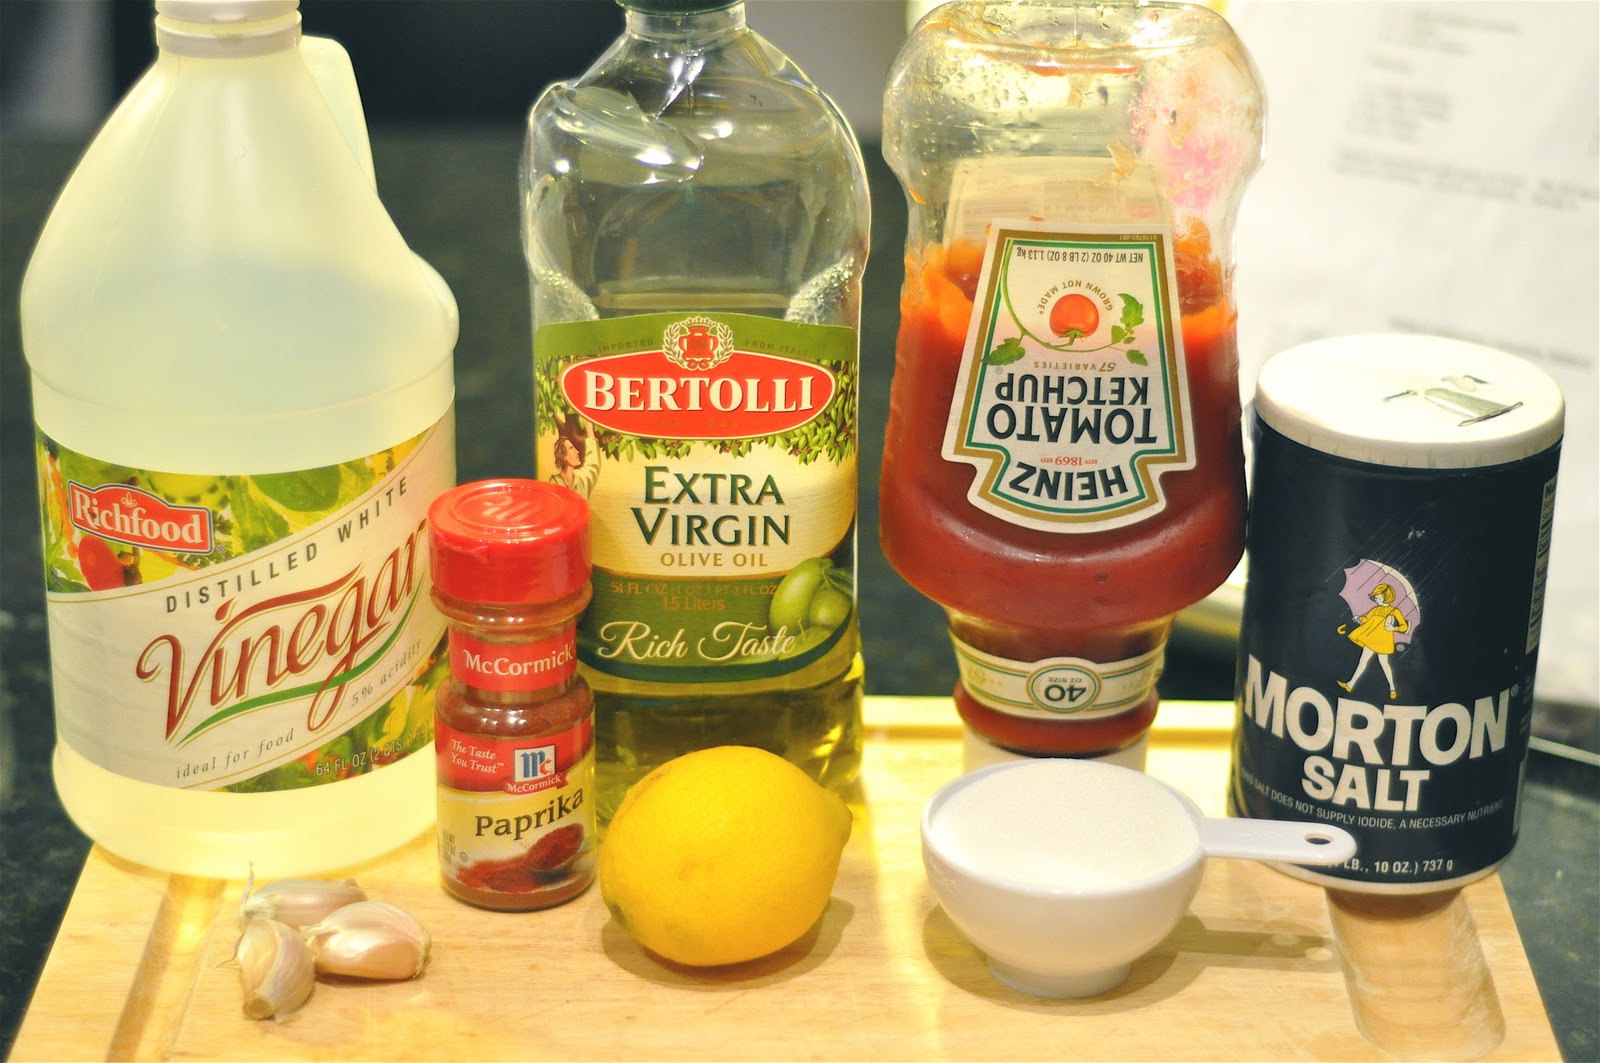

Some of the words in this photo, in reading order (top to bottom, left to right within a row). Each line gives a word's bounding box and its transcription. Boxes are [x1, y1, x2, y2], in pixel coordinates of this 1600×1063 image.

[1016, 246, 1026, 260] kg
[1028, 249, 1045, 261] 1.13
[1047, 249, 1060, 262] OZ)
[1061, 251, 1068, 261] 8
[1069, 251, 1080, 262] LB
[1081, 250, 1090, 263] (2
[1091, 252, 1102, 263] OZ
[1103, 252, 1114, 263] 40
[1115, 252, 1128, 263] WT
[1129, 251, 1144, 263] NET
[1061, 279, 1082, 289] NOT
[1085, 281, 1113, 312] GROWN
[744, 338, 774, 352] FROM
[1032, 360, 1097, 372] VARIETIES
[1098, 361, 1117, 373] 57
[583, 369, 815, 413] BERTOLLI
[995, 373, 1149, 406] KETCHUP
[986, 403, 1158, 445] TOMATO
[1054, 456, 1083, 466] 1869
[644, 466, 786, 506] EXTRA
[1008, 461, 1129, 502] HEINZ
[73, 488, 205, 546] Richfood
[631, 507, 791, 547] VIRGIN
[165, 541, 319, 615] DISTILLED
[336, 476, 407, 544] WHITE
[660, 551, 724, 568] OLIVE
[732, 551, 769, 568] OIL
[627, 582, 641, 594] FL
[743, 585, 756, 596] FL
[684, 597, 727, 612] Liters
[136, 518, 427, 741] Vinegar
[597, 620, 689, 661] Rich
[697, 621, 797, 660] Taste
[462, 643, 573, 677] McCormick
[350, 683, 374, 708] 5%
[380, 639, 422, 686] acidity
[1047, 676, 1068, 684] SIZE
[1069, 676, 1083, 684] OZ
[1043, 683, 1087, 703] 40
[1244, 653, 1511, 767] MORTON
[175, 756, 216, 779] ideal
[224, 749, 251, 770] for
[257, 726, 295, 758] food
[315, 763, 330, 776] 64
[334, 757, 348, 772] FL
[351, 751, 367, 768] OZ
[384, 737, 406, 757] QTS)
[450, 738, 467, 754] The
[469, 744, 497, 761] Taste
[450, 750, 468, 767] You
[506, 774, 562, 794] McCormick
[1301, 754, 1431, 812] SALT
[1253, 777, 1271, 797] SALT
[1271, 788, 1293, 808] DOES
[1295, 800, 1315, 816] NOT
[1316, 807, 1355, 825] SUPPLY
[1357, 815, 1396, 830] IODIDE,
[1399, 818, 1407, 829] A
[1409, 812, 1467, 829] NECESSARY
[1467, 797, 1503, 820] NUTRIENT
[474, 787, 584, 842] Paprika
[1374, 860, 1389, 873] 10
[1392, 860, 1419, 875] OZ.)
[1422, 858, 1444, 873] 737
[1446, 859, 1453, 872] g
